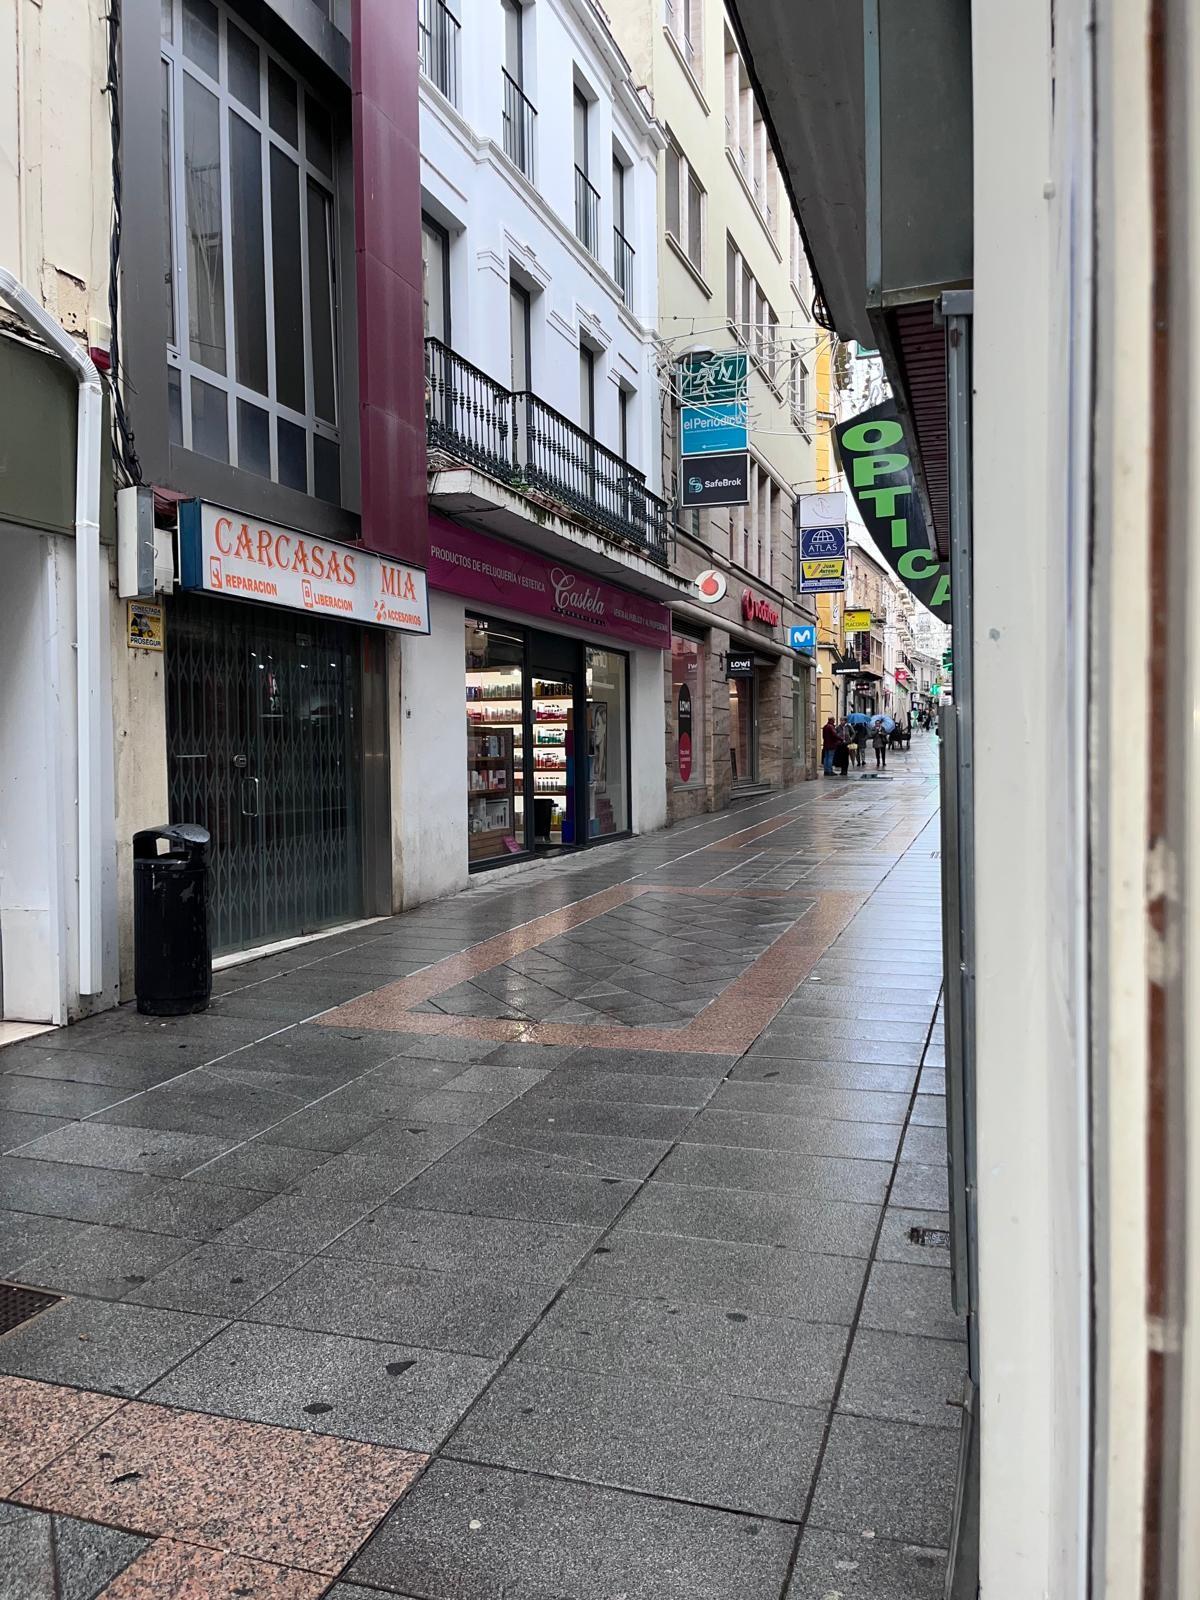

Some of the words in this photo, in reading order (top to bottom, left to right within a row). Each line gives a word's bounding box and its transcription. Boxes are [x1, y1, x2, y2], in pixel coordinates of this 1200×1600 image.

[704, 477, 742, 488] SafeBrok
[808, 543, 838, 553] ATLAS
[215, 517, 357, 588] CARCASAS
[380, 564, 418, 603] MIA
[430, 545, 472, 569] PRODUCTOS
[472, 560, 482, 572] DE
[225, 573, 278, 597] REPARACION
[550, 567, 605, 616] Castela
[313, 592, 353, 612] LIBERACION
[386, 609, 422, 627] ACCESORIOS
[130, 637, 162, 647] PROSEGUR
